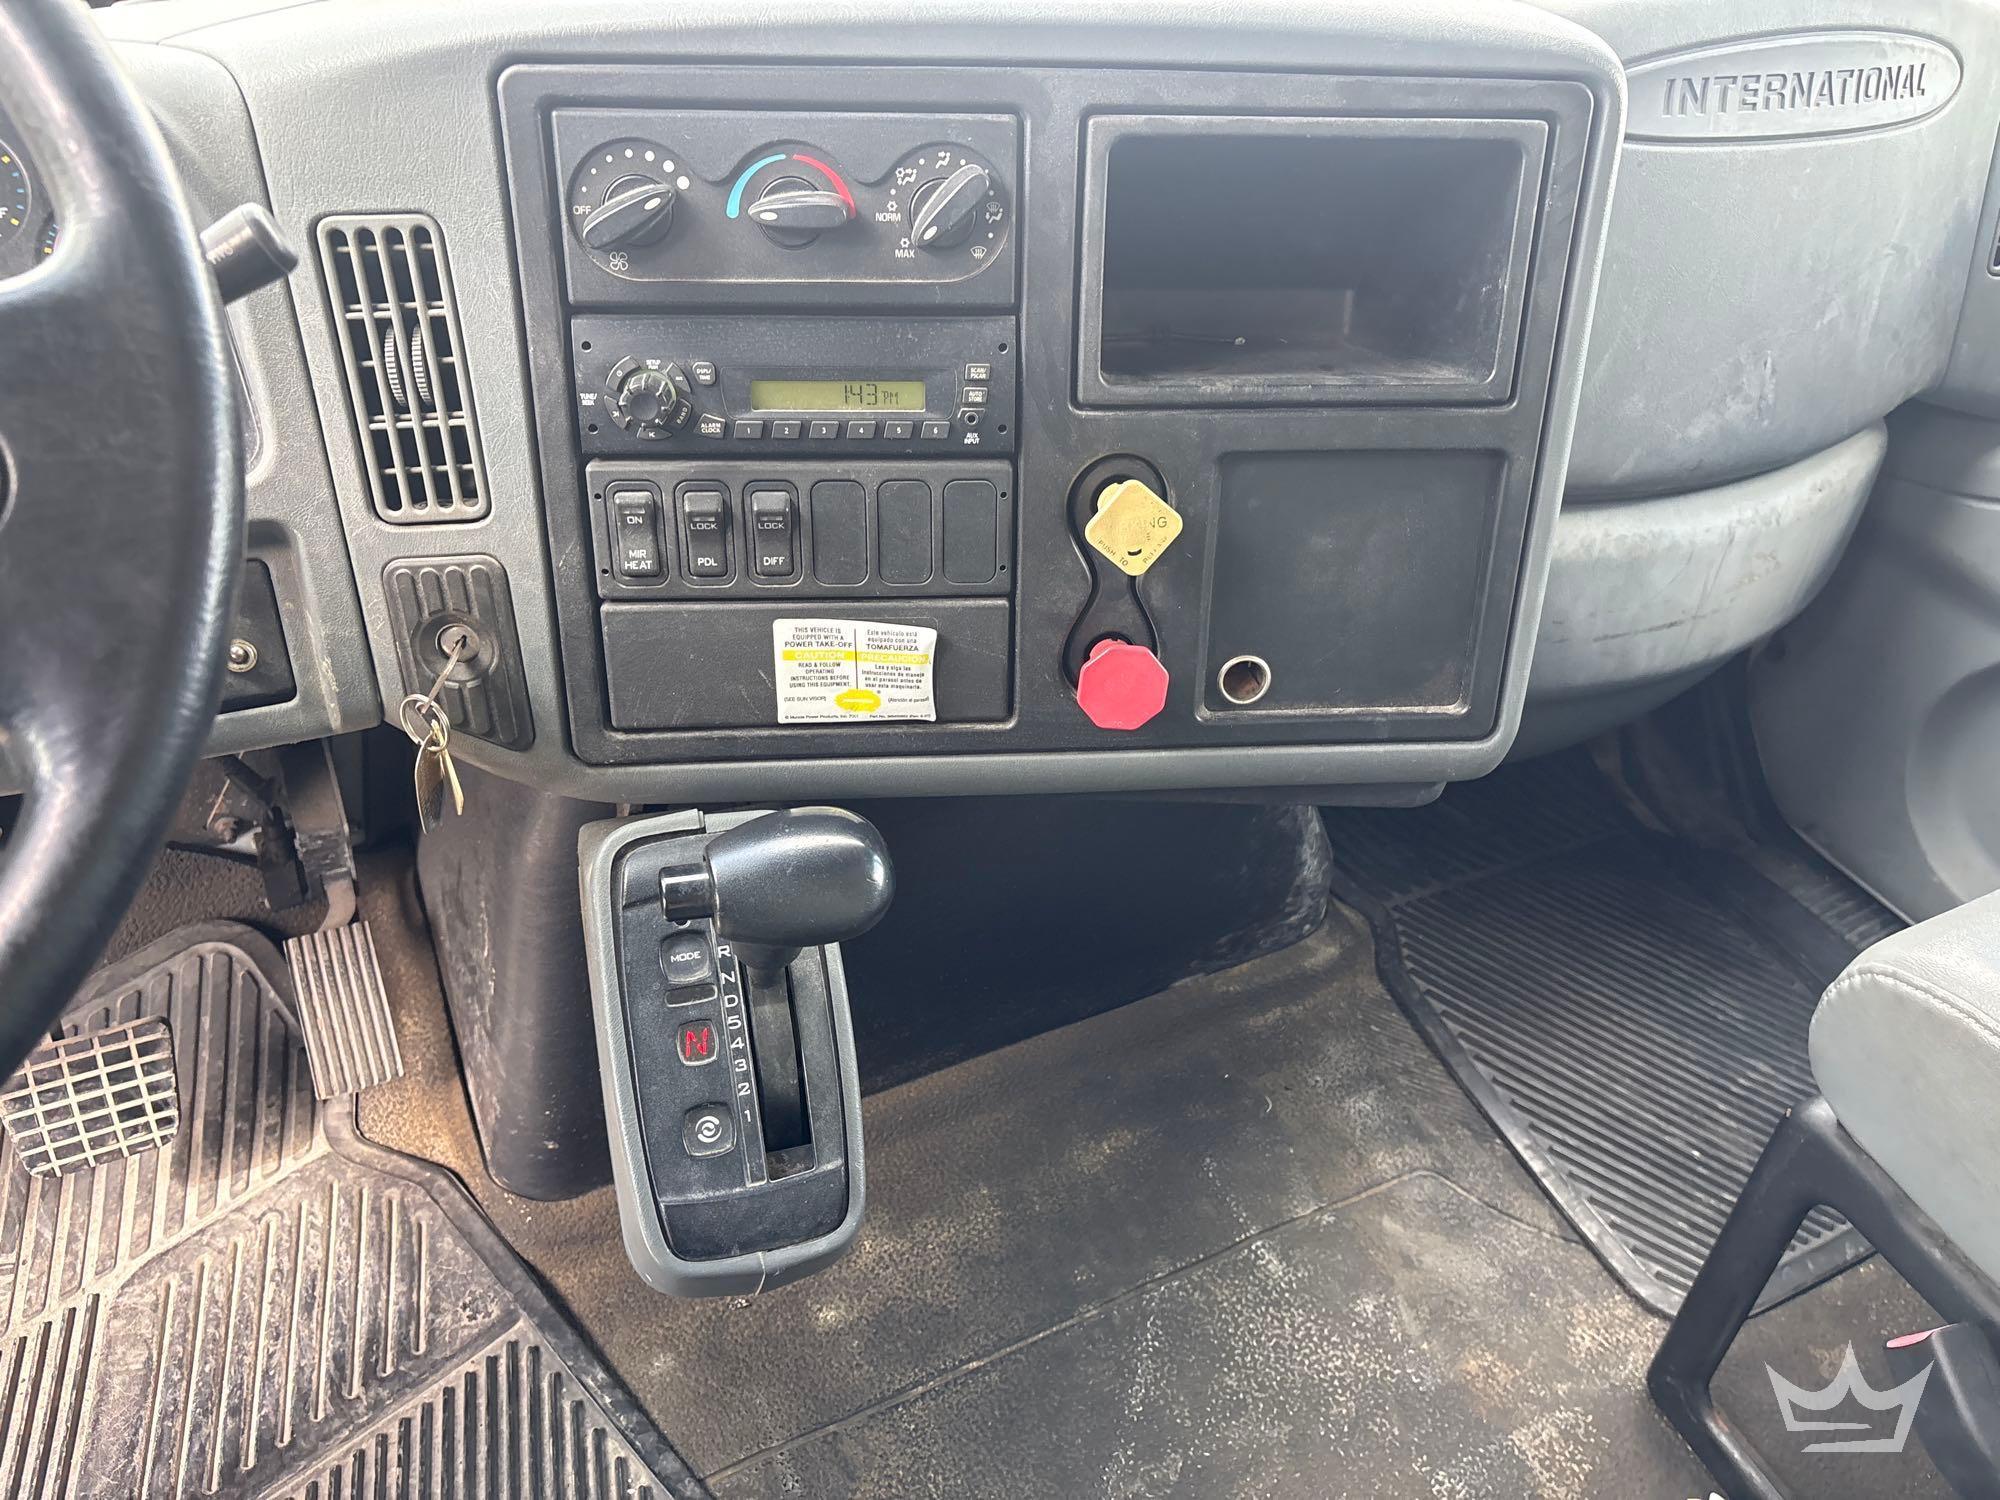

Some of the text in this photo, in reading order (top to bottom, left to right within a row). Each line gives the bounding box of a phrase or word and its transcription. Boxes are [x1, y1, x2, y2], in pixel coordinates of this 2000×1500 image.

[1661, 63, 1926, 118] INTERNATIONAL
[573, 205, 592, 215] OFF
[876, 212, 902, 222] NORM
[895, 249, 916, 259] MAX
[882, 390, 899, 405] PM
[677, 407, 688, 424] BAND
[783, 426, 789, 435] 2
[626, 516, 643, 524] ON
[629, 550, 647, 559] MIR
[1097, 539, 1129, 567] PUSH TO
[625, 560, 652, 570] HEAT
[697, 558, 718, 567] PDL
[763, 557, 785, 566] DIFF
[866, 643, 919, 651] TOMAFUERZA
[794, 651, 844, 660] CAUTION
[670, 951, 701, 963] MODE
[717, 945, 731, 958] R
[721, 971, 736, 984] N
[724, 995, 739, 1008] D
[727, 1015, 741, 1030] 5
[685, 1027, 709, 1057] N
[730, 1036, 745, 1050] 4
[734, 1058, 747, 1072] 3
[738, 1082, 750, 1096] 2
[744, 1109, 751, 1122] 1
